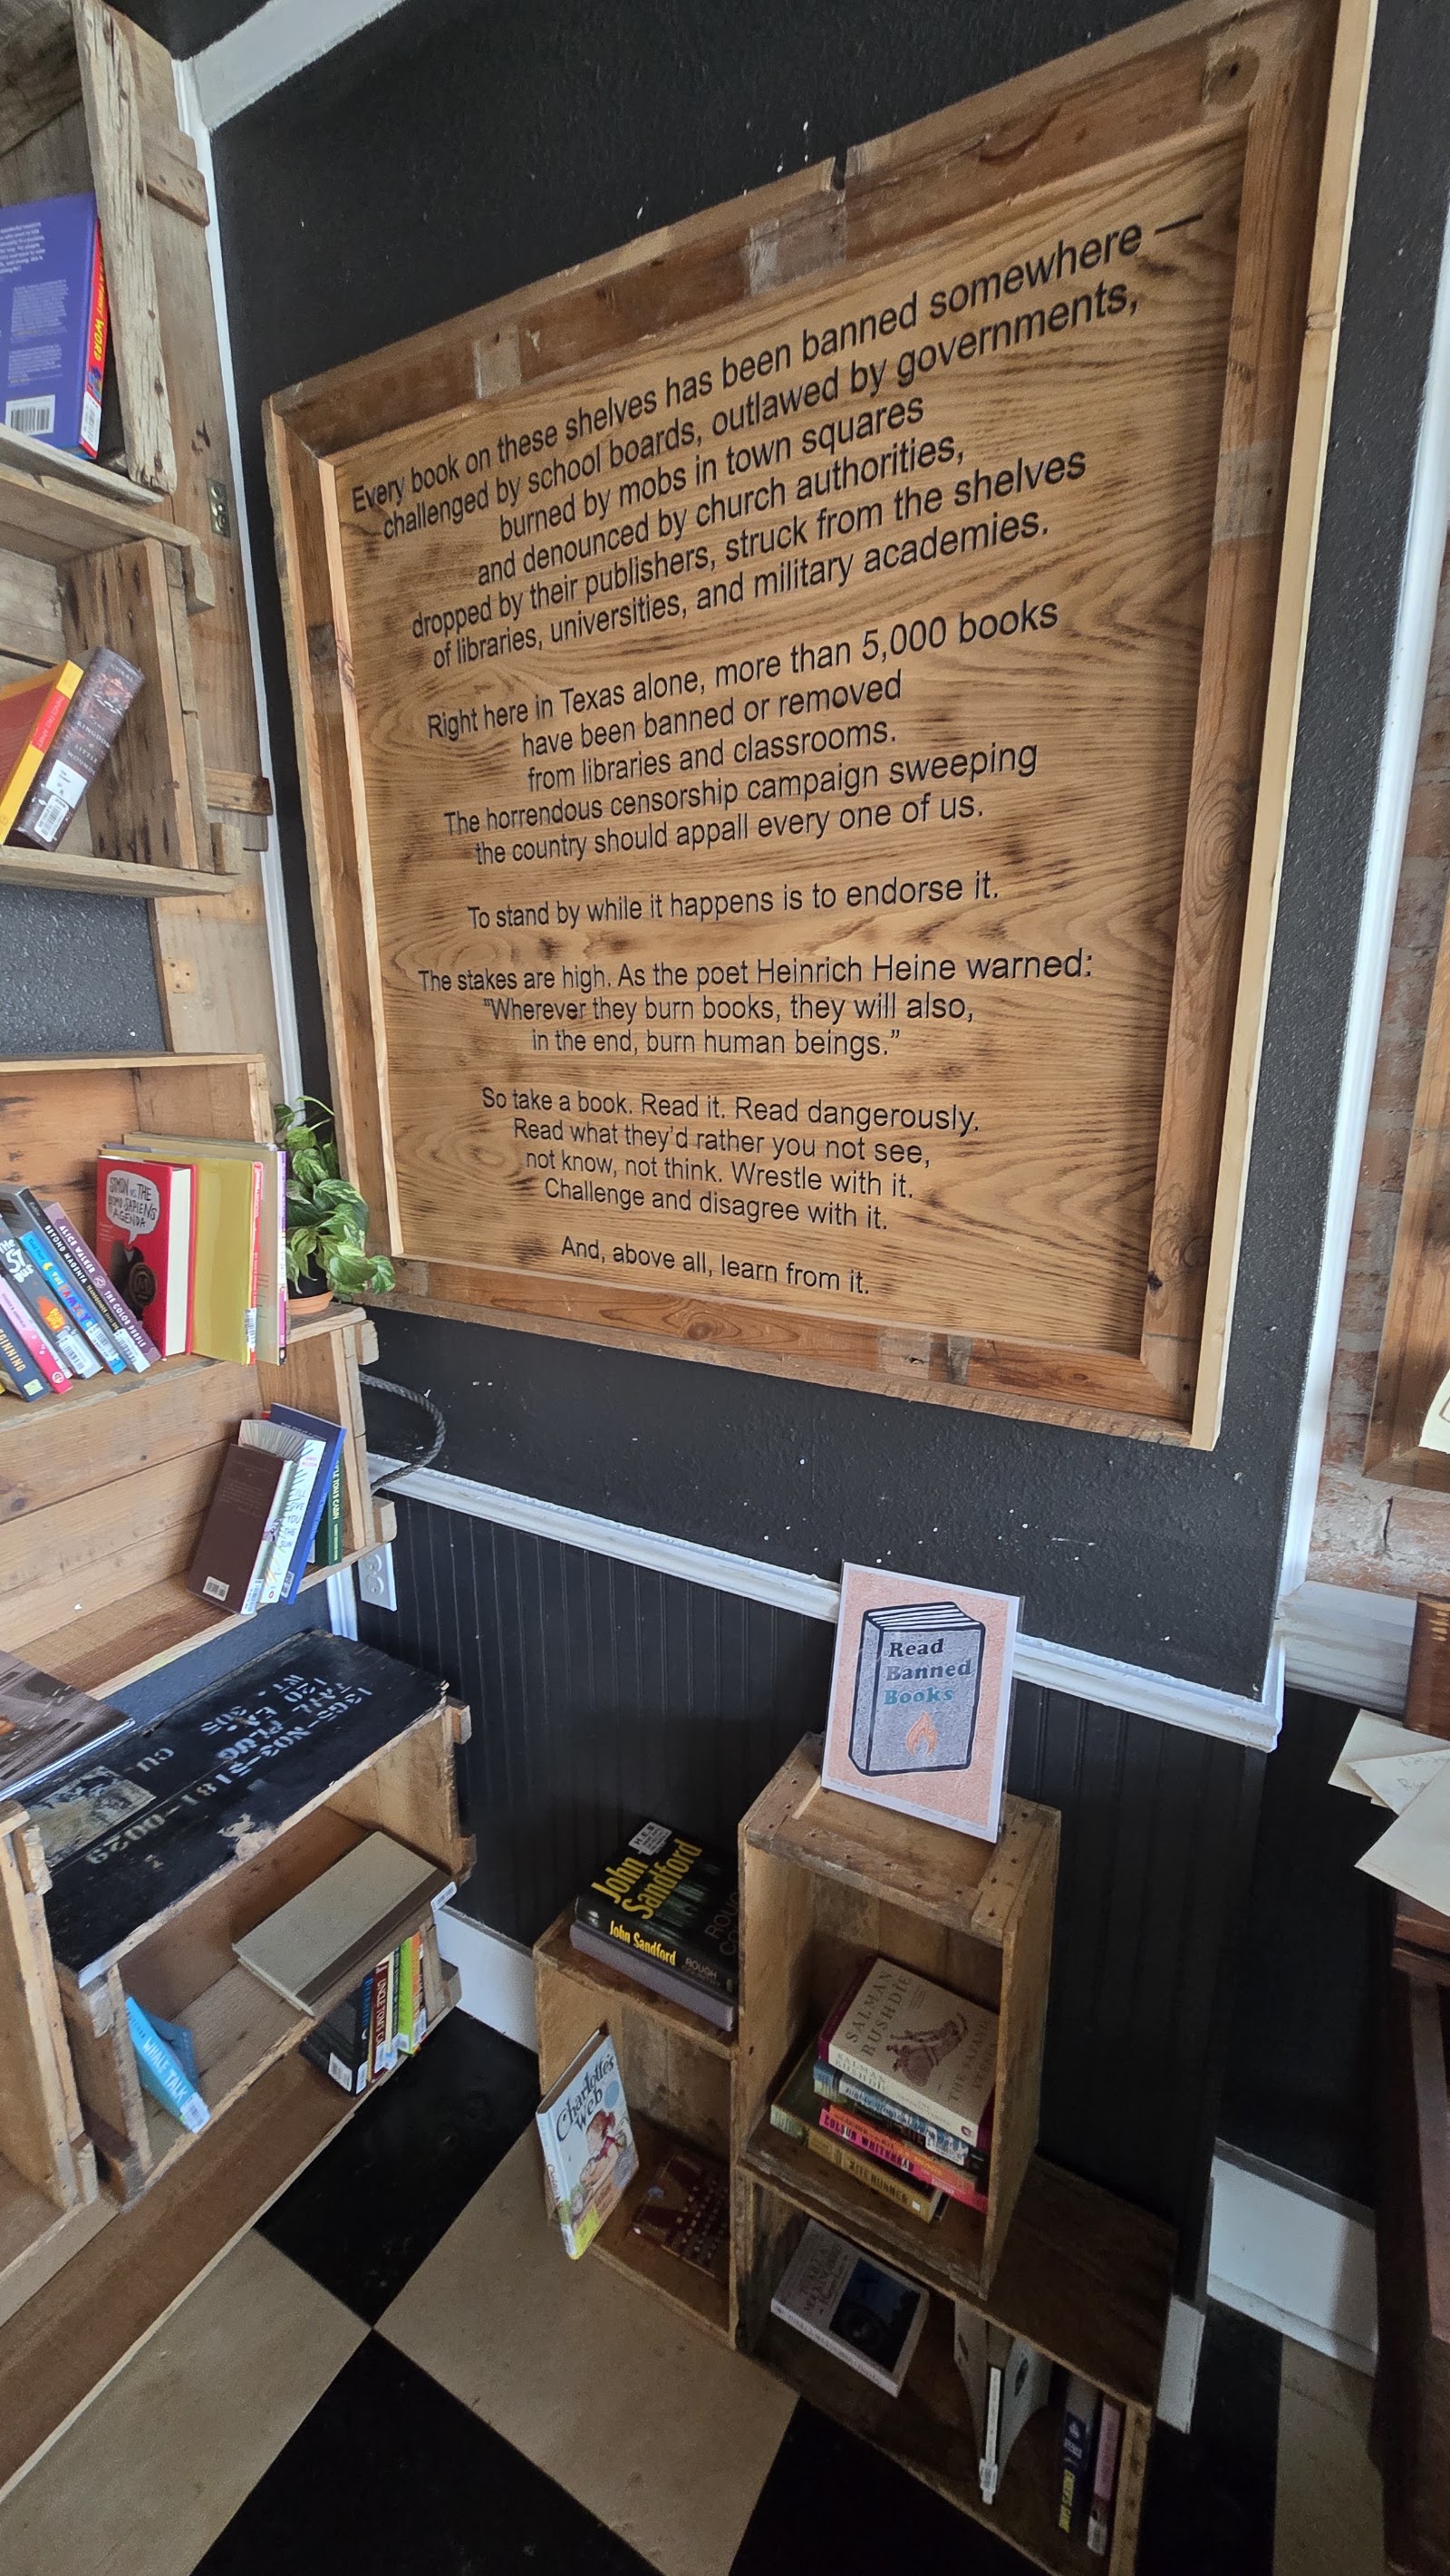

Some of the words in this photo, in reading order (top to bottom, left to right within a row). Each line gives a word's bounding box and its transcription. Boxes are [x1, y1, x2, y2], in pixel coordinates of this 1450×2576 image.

[94, 319, 105, 360] WORD
[352, 476, 406, 514] Every
[411, 453, 460, 493] book
[466, 448, 491, 475] on
[497, 425, 558, 464] these
[566, 390, 657, 441] shelves
[666, 371, 713, 408] has
[722, 344, 791, 390] been
[802, 290, 917, 363] banned
[929, 224, 1142, 320] somewhere
[382, 480, 490, 541] challenged
[496, 477, 520, 508] by
[527, 443, 601, 494] school
[609, 417, 702, 469] boards,
[711, 365, 838, 436] outlawed
[850, 358, 887, 398] by
[897, 280, 1137, 388] governments,
[478, 549, 516, 586] and
[523, 511, 649, 573] denounced
[658, 508, 688, 542] by
[696, 476, 786, 528] church
[796, 436, 963, 500] authorities,
[412, 594, 492, 639] dropped
[498, 591, 524, 622] by
[529, 578, 578, 610] their
[585, 546, 715, 604] publishers,
[725, 515, 808, 562] struck
[817, 502, 883, 540] from
[894, 486, 942, 521] the
[954, 450, 1086, 507] shelves
[428, 707, 478, 742] Right
[483, 703, 528, 730] here
[536, 693, 554, 721] in
[559, 684, 625, 714] Texas
[633, 671, 705, 702] alone,
[716, 655, 781, 687] more
[790, 642, 851, 673] than
[862, 615, 947, 663] 5,000
[959, 599, 1058, 644] books
[522, 731, 573, 758] have
[580, 721, 635, 749] been
[644, 696, 734, 739] banned
[744, 698, 770, 722] or
[779, 668, 902, 718] removed
[474, 841, 506, 866] the
[512, 833, 587, 862] country
[594, 820, 668, 854] should
[676, 812, 748, 851] appall
[758, 810, 830, 839] every
[839, 804, 892, 830] one
[902, 791, 932, 824] of
[941, 795, 983, 821] us.
[467, 905, 490, 929] To
[496, 901, 549, 928] stand
[556, 900, 581, 930] by
[586, 896, 643, 922] while
[651, 894, 663, 918] it
[671, 891, 774, 923] happens
[784, 884, 804, 912] is
[812, 883, 836, 909] to
[846, 876, 963, 907] endorse
[975, 870, 999, 900] it.
[417, 970, 452, 992] The
[458, 968, 517, 991] stakes
[523, 971, 556, 990] are
[562, 964, 612, 995] high.
[617, 963, 646, 987] As
[652, 962, 688, 986] the
[696, 960, 749, 992] poet
[758, 955, 862, 984] Heinrich
[874, 954, 956, 982] Heine
[966, 947, 1092, 980] warned:
[592, 996, 637, 1026] they
[645, 995, 694, 1020] burn
[703, 993, 780, 1023] books,
[790, 993, 846, 1026] they
[854, 992, 895, 1019] will
[906, 991, 973, 1023] also,
[481, 1086, 507, 1109] So
[512, 1089, 553, 1111] take
[559, 1095, 571, 1112] a
[577, 1090, 633, 1115] book.
[642, 1092, 699, 1118] Read
[707, 1095, 726, 1119] it.
[735, 1096, 798, 1122] Read
[807, 1099, 980, 1138] dangerously.
[514, 1118, 564, 1142] Read
[570, 1121, 619, 1146] what
[624, 1123, 689, 1154] they'd
[697, 1128, 766, 1155] rather
[772, 1137, 817, 1162] you
[826, 1137, 865, 1161] not
[875, 1143, 930, 1169] see,
[109, 1177, 129, 1196] SIMON
[137, 1183, 152, 1202] THE
[123, 1198, 158, 1221] SAPIENS
[112, 1210, 146, 1227] AGENDA
[5, 1248, 25, 1273] 57
[44, 1224, 66, 1255] BEYOND
[63, 1253, 88, 1284] MAGENTA
[561, 1235, 606, 1264] And,
[613, 1243, 675, 1270] above
[682, 1251, 712, 1278] all,
[721, 1254, 778, 1283] learn
[786, 1262, 840, 1291] from
[850, 1271, 870, 1295] it.
[58, 1284, 91, 1323] FAMILY
[59, 1225, 76, 1247] ALICE
[74, 1245, 96, 1273] WALKER
[103, 1290, 114, 1307] THE
[111, 1303, 130, 1326] COLOR
[127, 1324, 147, 1348] PURPLE
[332, 1499, 341, 1520] CABIN
[885, 1659, 974, 1681] Banned
[888, 1638, 944, 1658] Read
[884, 1687, 954, 1706] Books
[591, 1856, 649, 1904] John
[622, 1838, 703, 1920] Sandford
[609, 1920, 631, 1944] John
[633, 1932, 678, 1966] Sandford
[685, 1957, 718, 1980] ROUGH
[376, 1979, 387, 2009] UNCLE
[845, 1970, 893, 2043] SALMAN
[861, 1974, 912, 2058] RUSHDIE
[142, 2038, 170, 2074] WHALE
[163, 2069, 188, 2103] TALK
[556, 2054, 615, 2142] Charlotte's
[575, 2087, 604, 2132] Web
